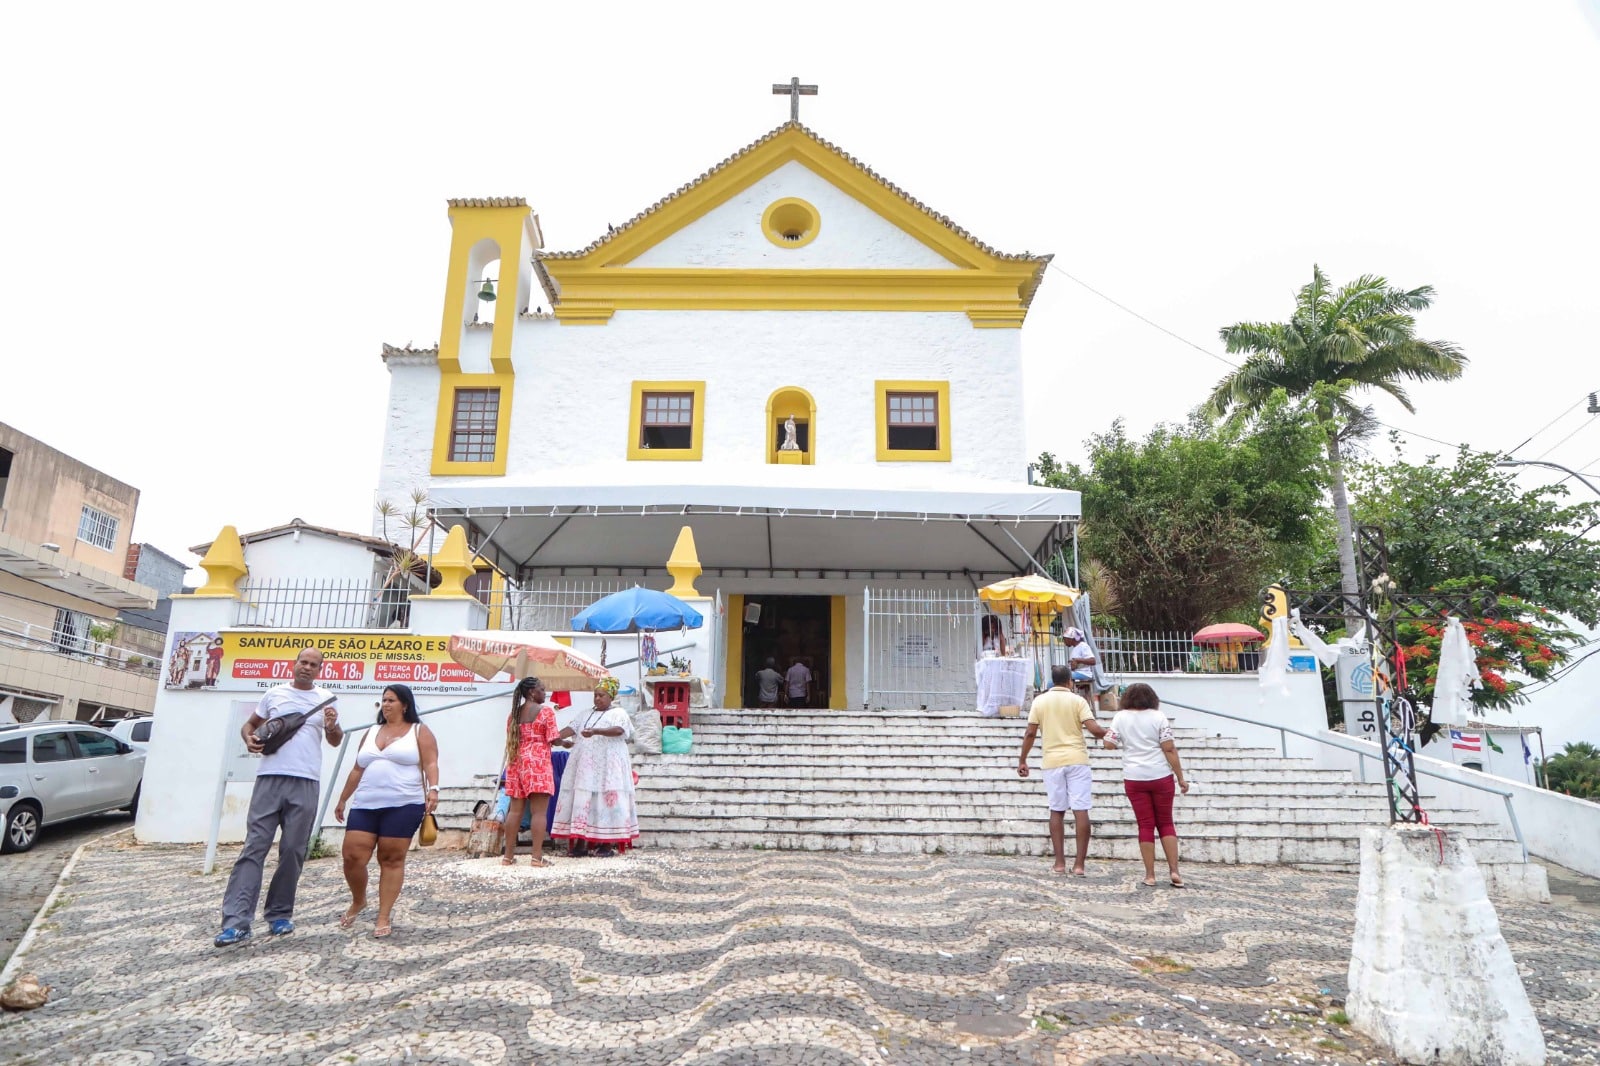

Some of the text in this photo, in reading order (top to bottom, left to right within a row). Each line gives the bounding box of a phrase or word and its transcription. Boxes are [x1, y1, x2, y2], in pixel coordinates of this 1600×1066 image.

[239, 636, 314, 649] SANTUÁRIO
[318, 639, 335, 649] DE
[338, 637, 366, 650] SÃO
[370, 638, 422, 651] LÁZARO
[426, 641, 434, 651] E
[457, 639, 516, 655] PURO MALTE
[321, 650, 425, 661] ORÁRIOS DE MISSAS:
[272, 662, 292, 678] 07h
[342, 662, 362, 679] 18h
